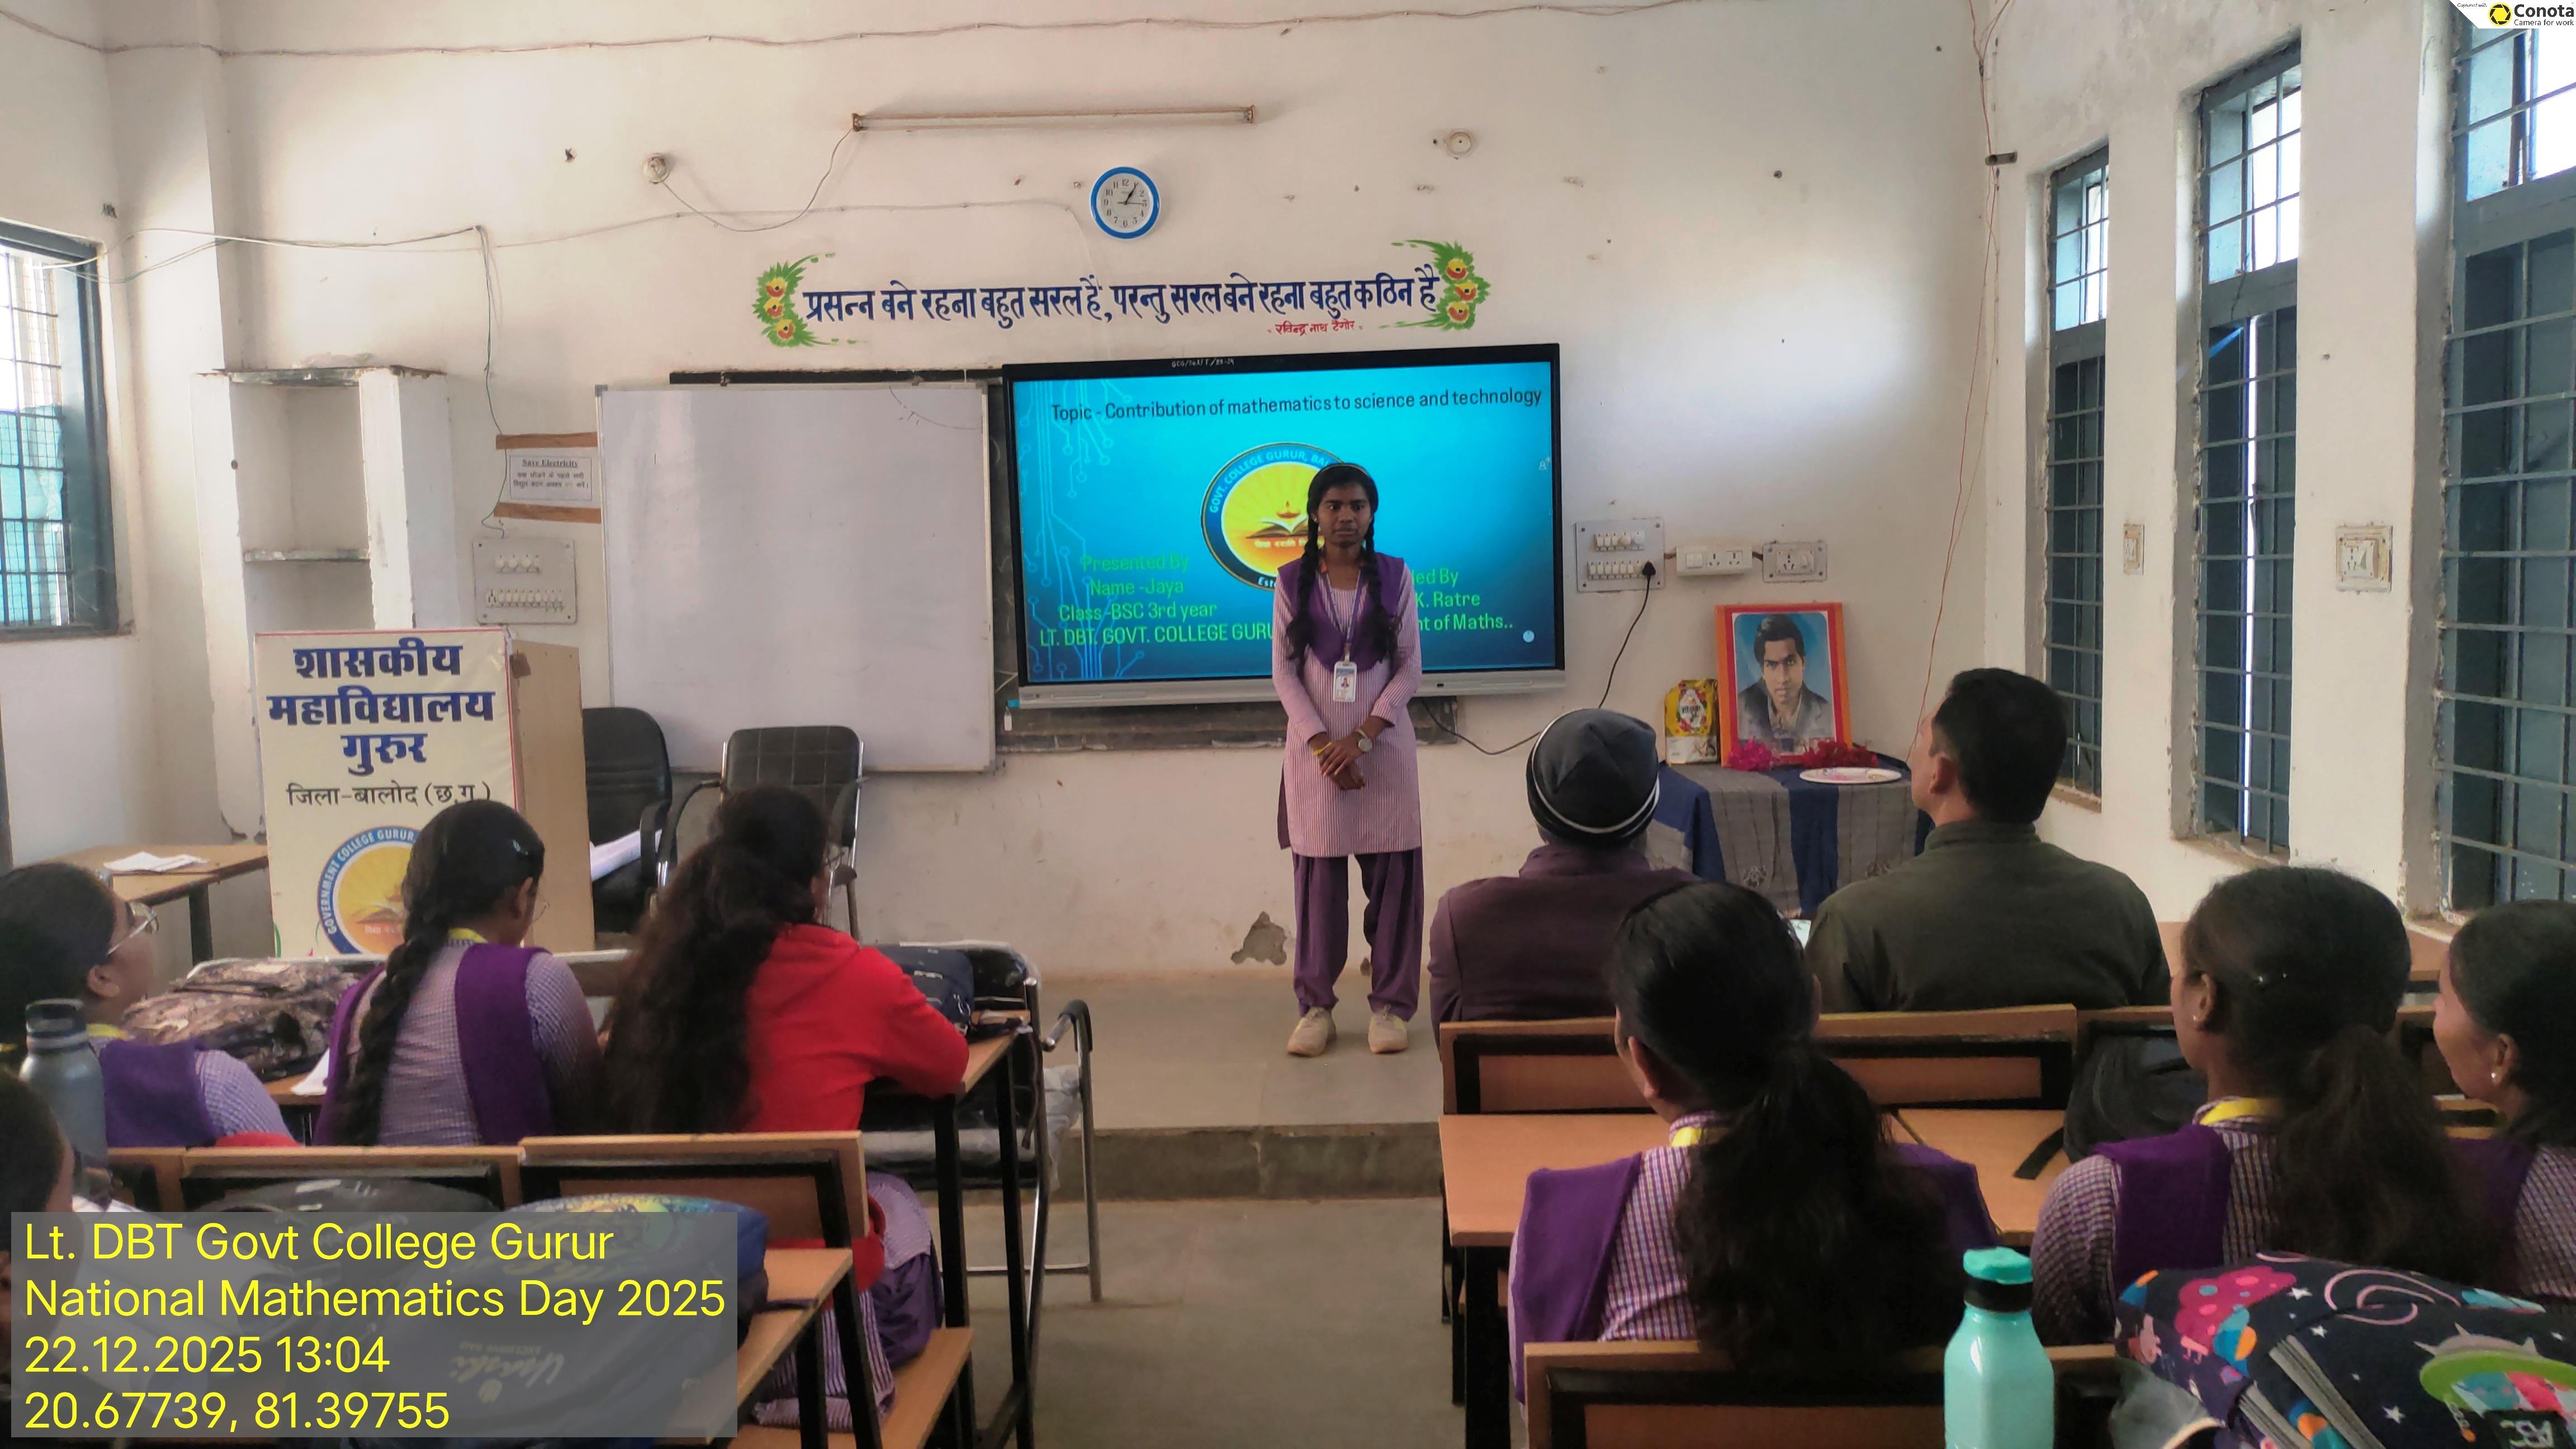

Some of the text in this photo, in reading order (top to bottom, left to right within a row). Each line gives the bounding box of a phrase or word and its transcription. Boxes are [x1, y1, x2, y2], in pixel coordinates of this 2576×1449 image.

[802, 289, 875, 323] प्रसन्न
[880, 280, 916, 322] बने
[920, 287, 977, 321] रहना
[979, 286, 1025, 329] बहुत
[1027, 286, 1082, 318] सरल
[1170, 283, 1223, 314] सरल
[1223, 272, 1258, 314] बने
[1258, 281, 1305, 315] रहना
[1309, 281, 1352, 320] बहुत
[1414, 263, 1441, 312] है
[1052, 404, 1092, 424] Topic
[1105, 400, 1205, 419] Contribution
[1209, 399, 1224, 416] of
[1228, 394, 1332, 415] mathematics
[1334, 396, 1351, 410] to
[1354, 392, 1415, 409] science
[1419, 390, 1449, 407] and
[1452, 387, 1542, 408] technology
[522, 459, 578, 468] Save Electricity
[1224, 456, 1264, 484] COLLEGE
[1082, 551, 1190, 573] Presented By
[1091, 579, 1135, 596] Name
[1439, 567, 1459, 588] By
[1433, 591, 1480, 608] Ratre
[1059, 604, 1102, 622] Class
[1148, 602, 1176, 619] 3rd
[1180, 603, 1218, 623] year
[1434, 614, 1450, 631] of
[1040, 629, 1060, 647] LT.
[1064, 627, 1097, 646] DBT.
[1103, 625, 1150, 645] GOVT.
[1154, 623, 1228, 643] COLLEGE
[293, 637, 463, 679] शासकीय
[266, 684, 496, 726] महाविद्यालय
[337, 831, 376, 861] COLLEGE
